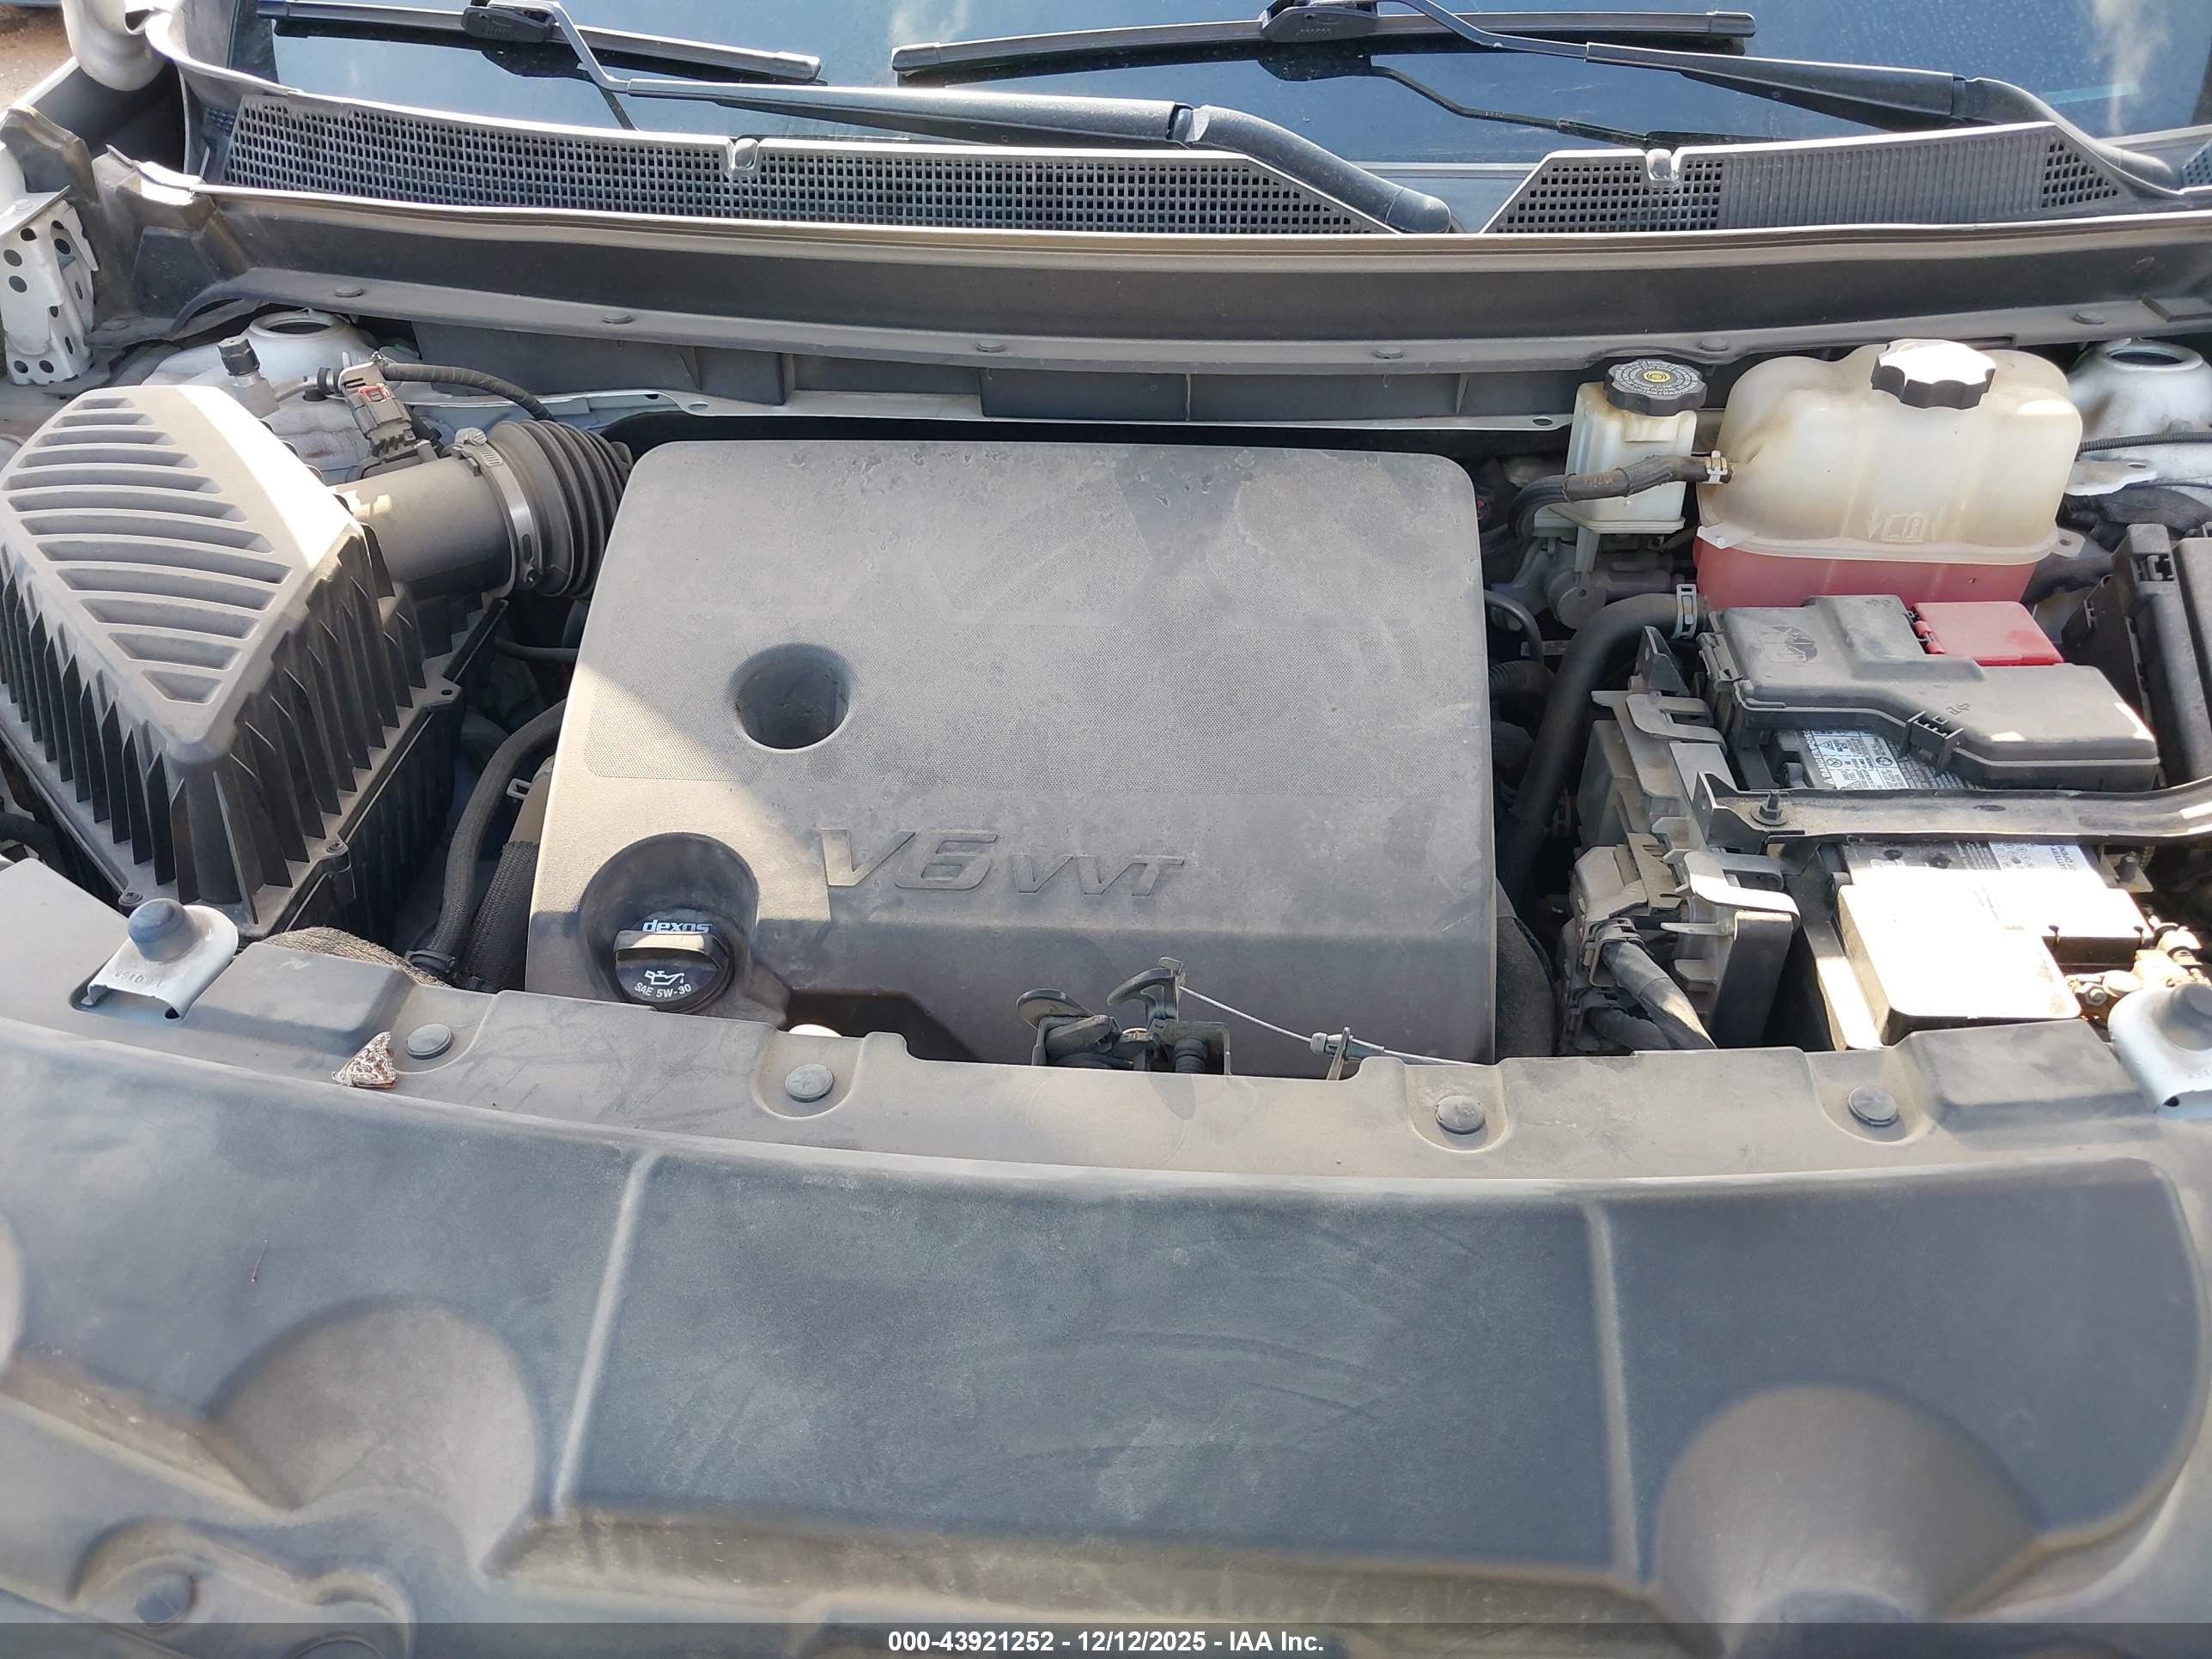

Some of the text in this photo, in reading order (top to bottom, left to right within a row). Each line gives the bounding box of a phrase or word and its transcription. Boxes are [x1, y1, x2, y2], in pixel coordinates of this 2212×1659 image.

[821, 828, 1185, 897] V6 VVT
[642, 919, 713, 934] dexos
[634, 981, 692, 999] SAE 5W-30
